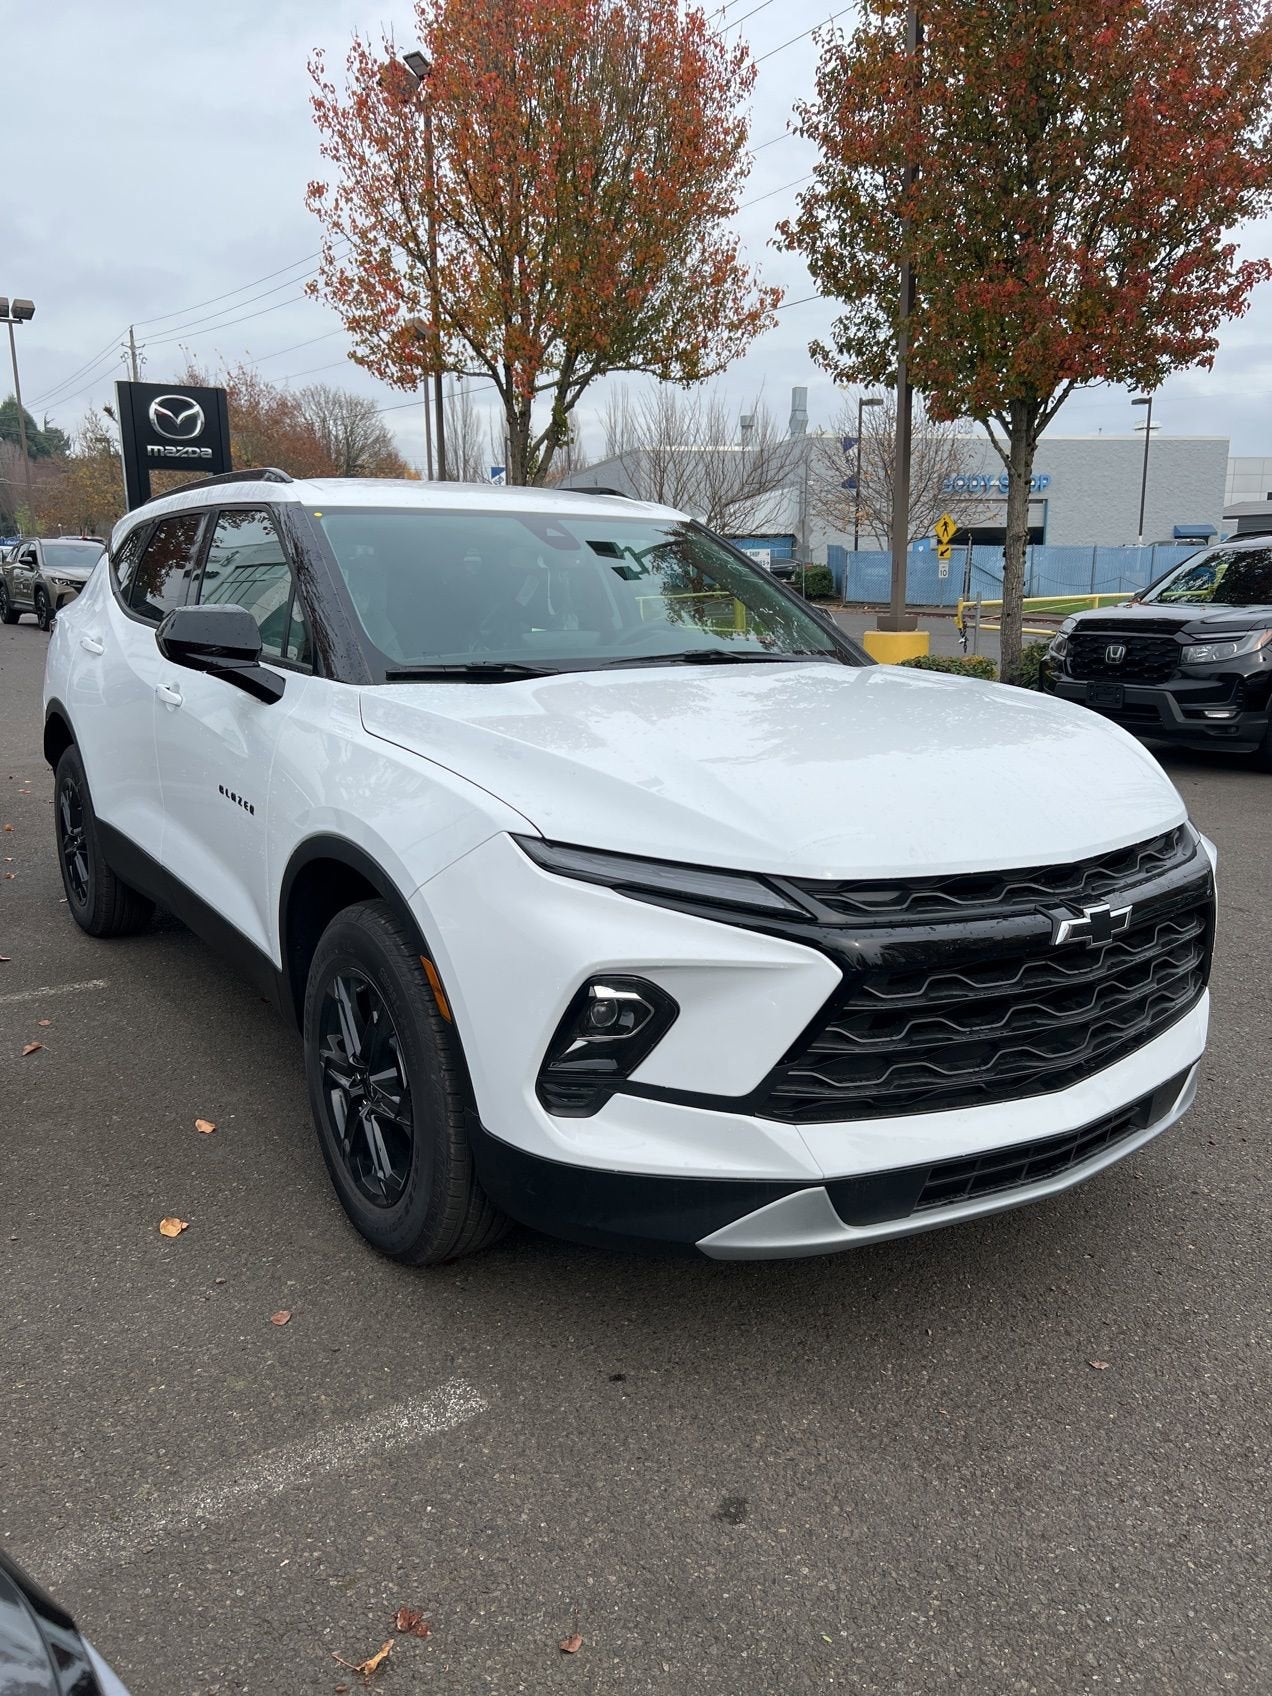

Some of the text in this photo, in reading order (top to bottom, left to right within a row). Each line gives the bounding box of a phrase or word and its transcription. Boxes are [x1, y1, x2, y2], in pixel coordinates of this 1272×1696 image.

[999, 474, 1051, 494] SOP
[940, 569, 948, 577] 10
[219, 784, 255, 816] BLAZER
